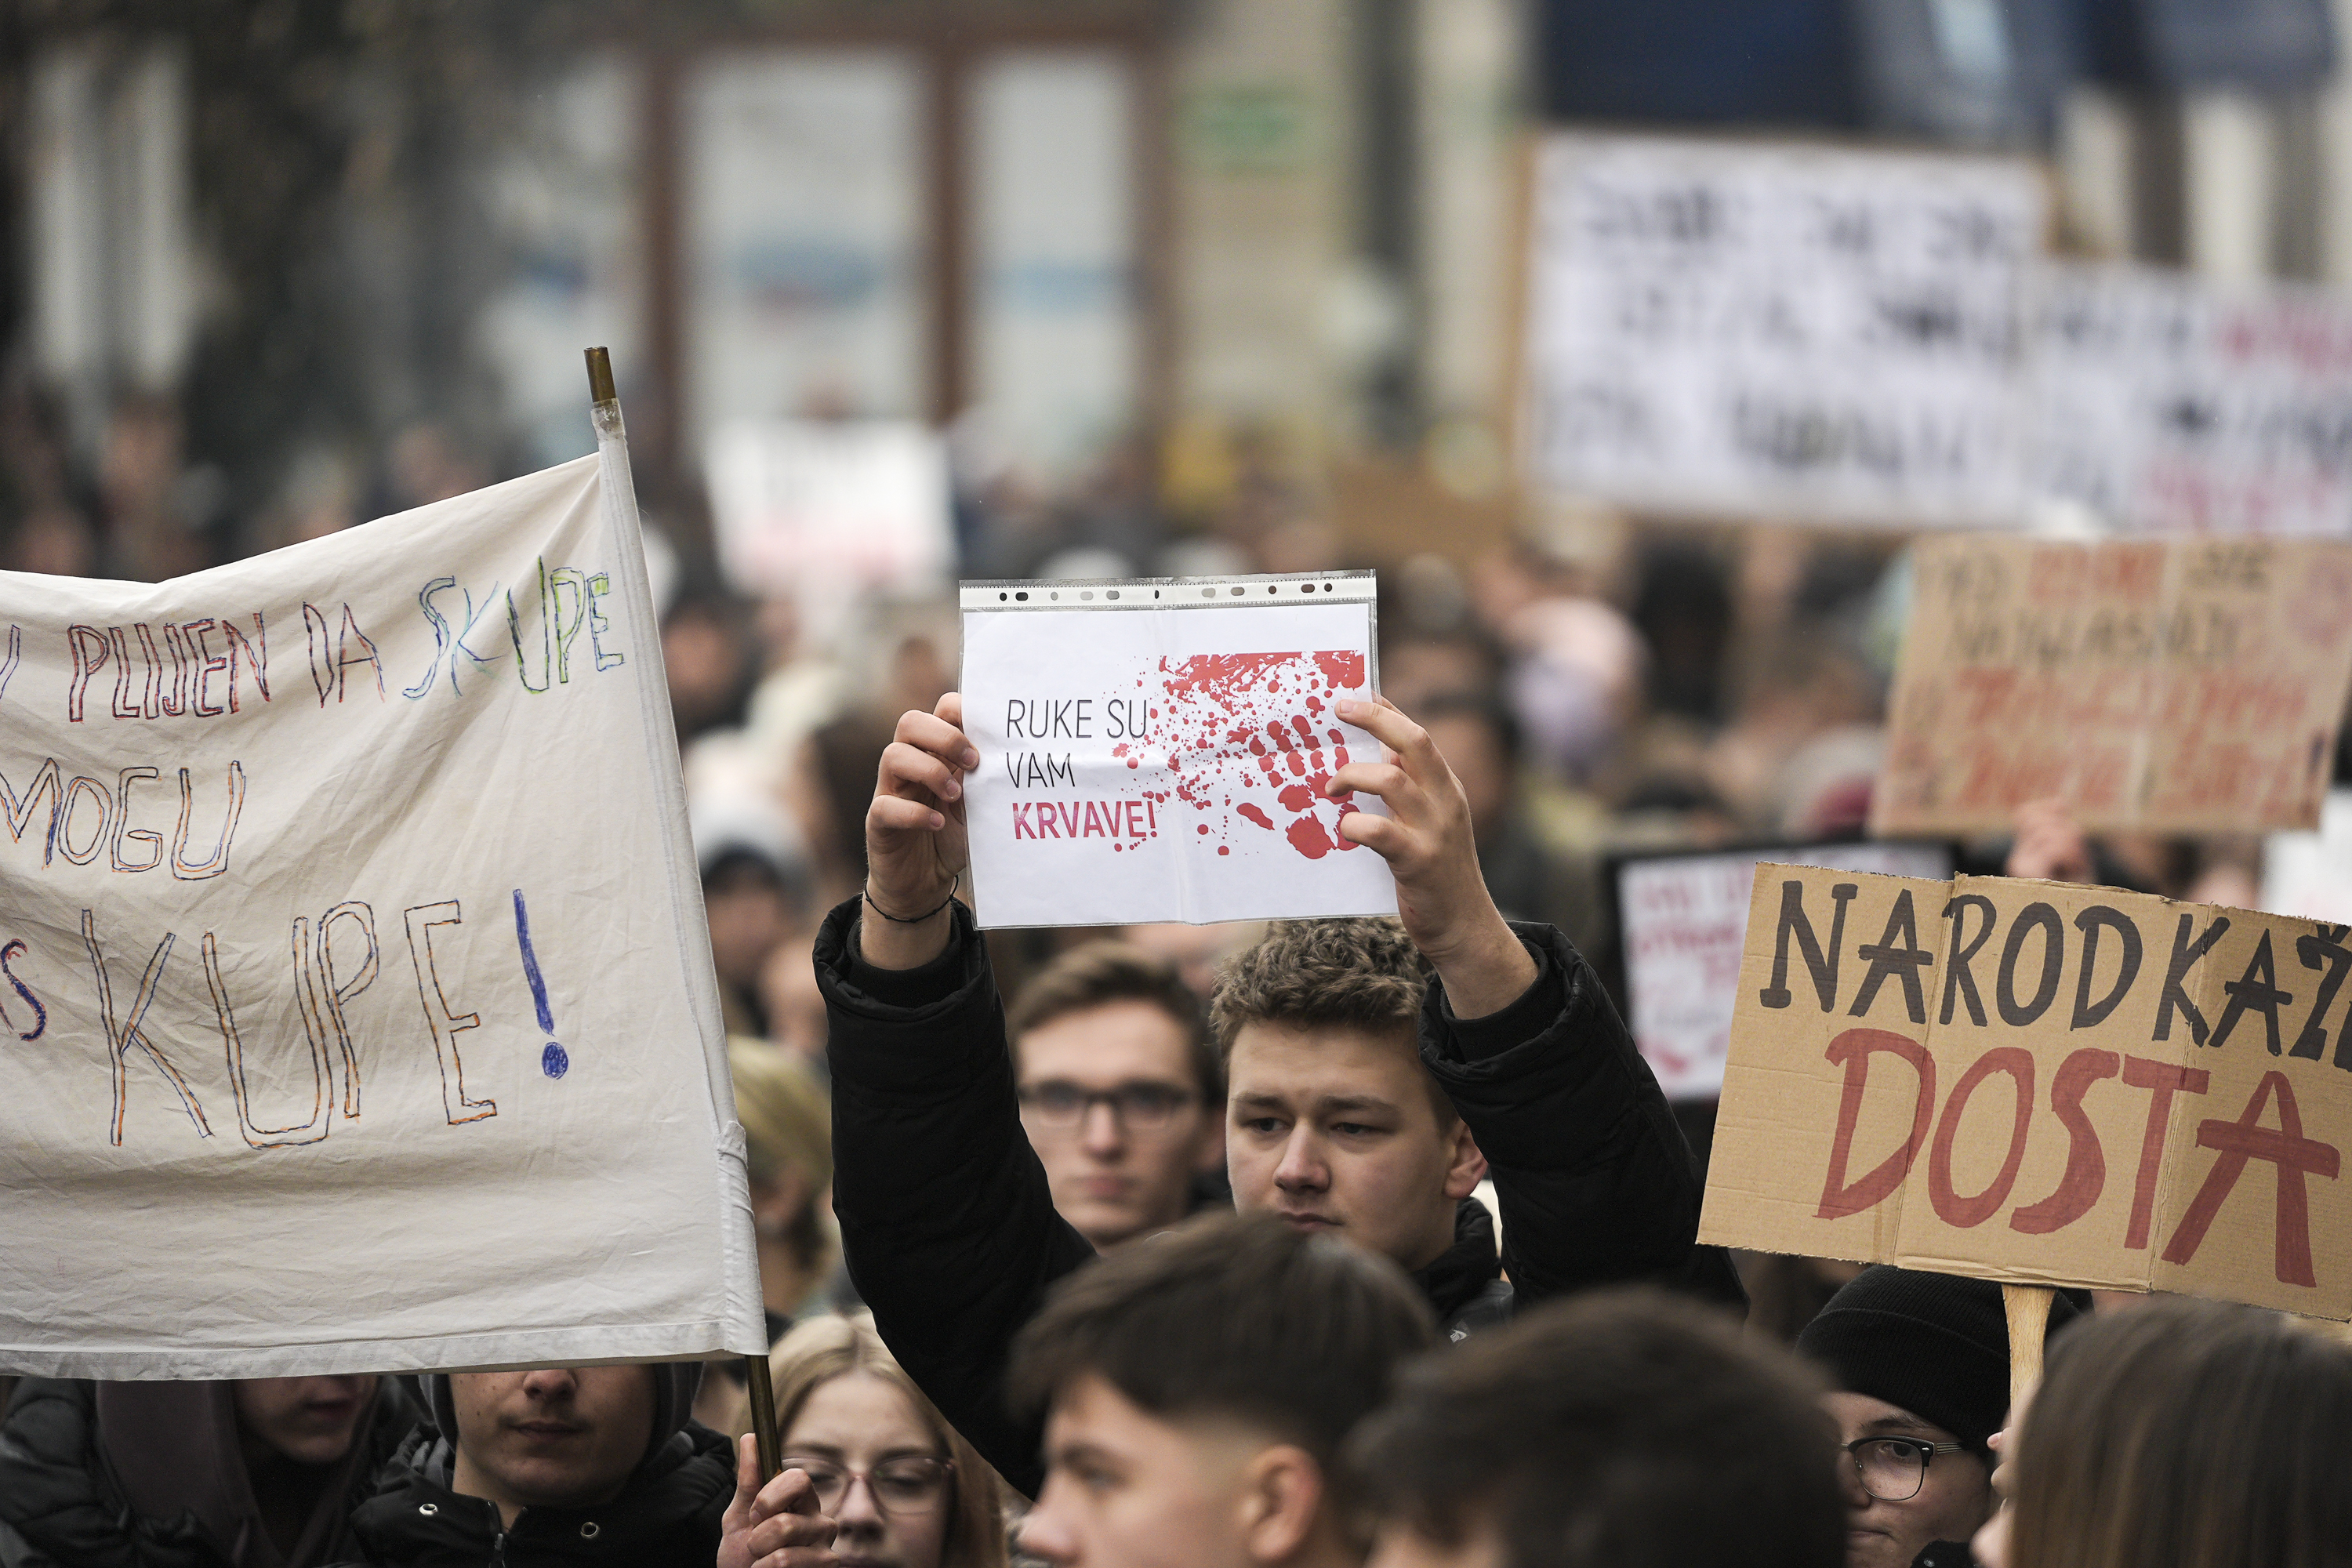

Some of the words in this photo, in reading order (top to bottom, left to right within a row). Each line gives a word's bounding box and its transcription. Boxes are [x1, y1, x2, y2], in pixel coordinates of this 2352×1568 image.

[67, 612, 272, 724] PLIJEN
[303, 601, 385, 708] DA
[402, 555, 624, 699] SKUPE
[1006, 753, 1075, 788] VAM
[1007, 699, 1092, 739] RUKE
[1107, 699, 1147, 739] SU
[1012, 800, 1156, 840] KRVAVE!
[1759, 880, 2143, 1032] NAROD
[2152, 913, 2352, 1073] KAŽ
[1813, 1027, 2340, 1288] DOSTA
